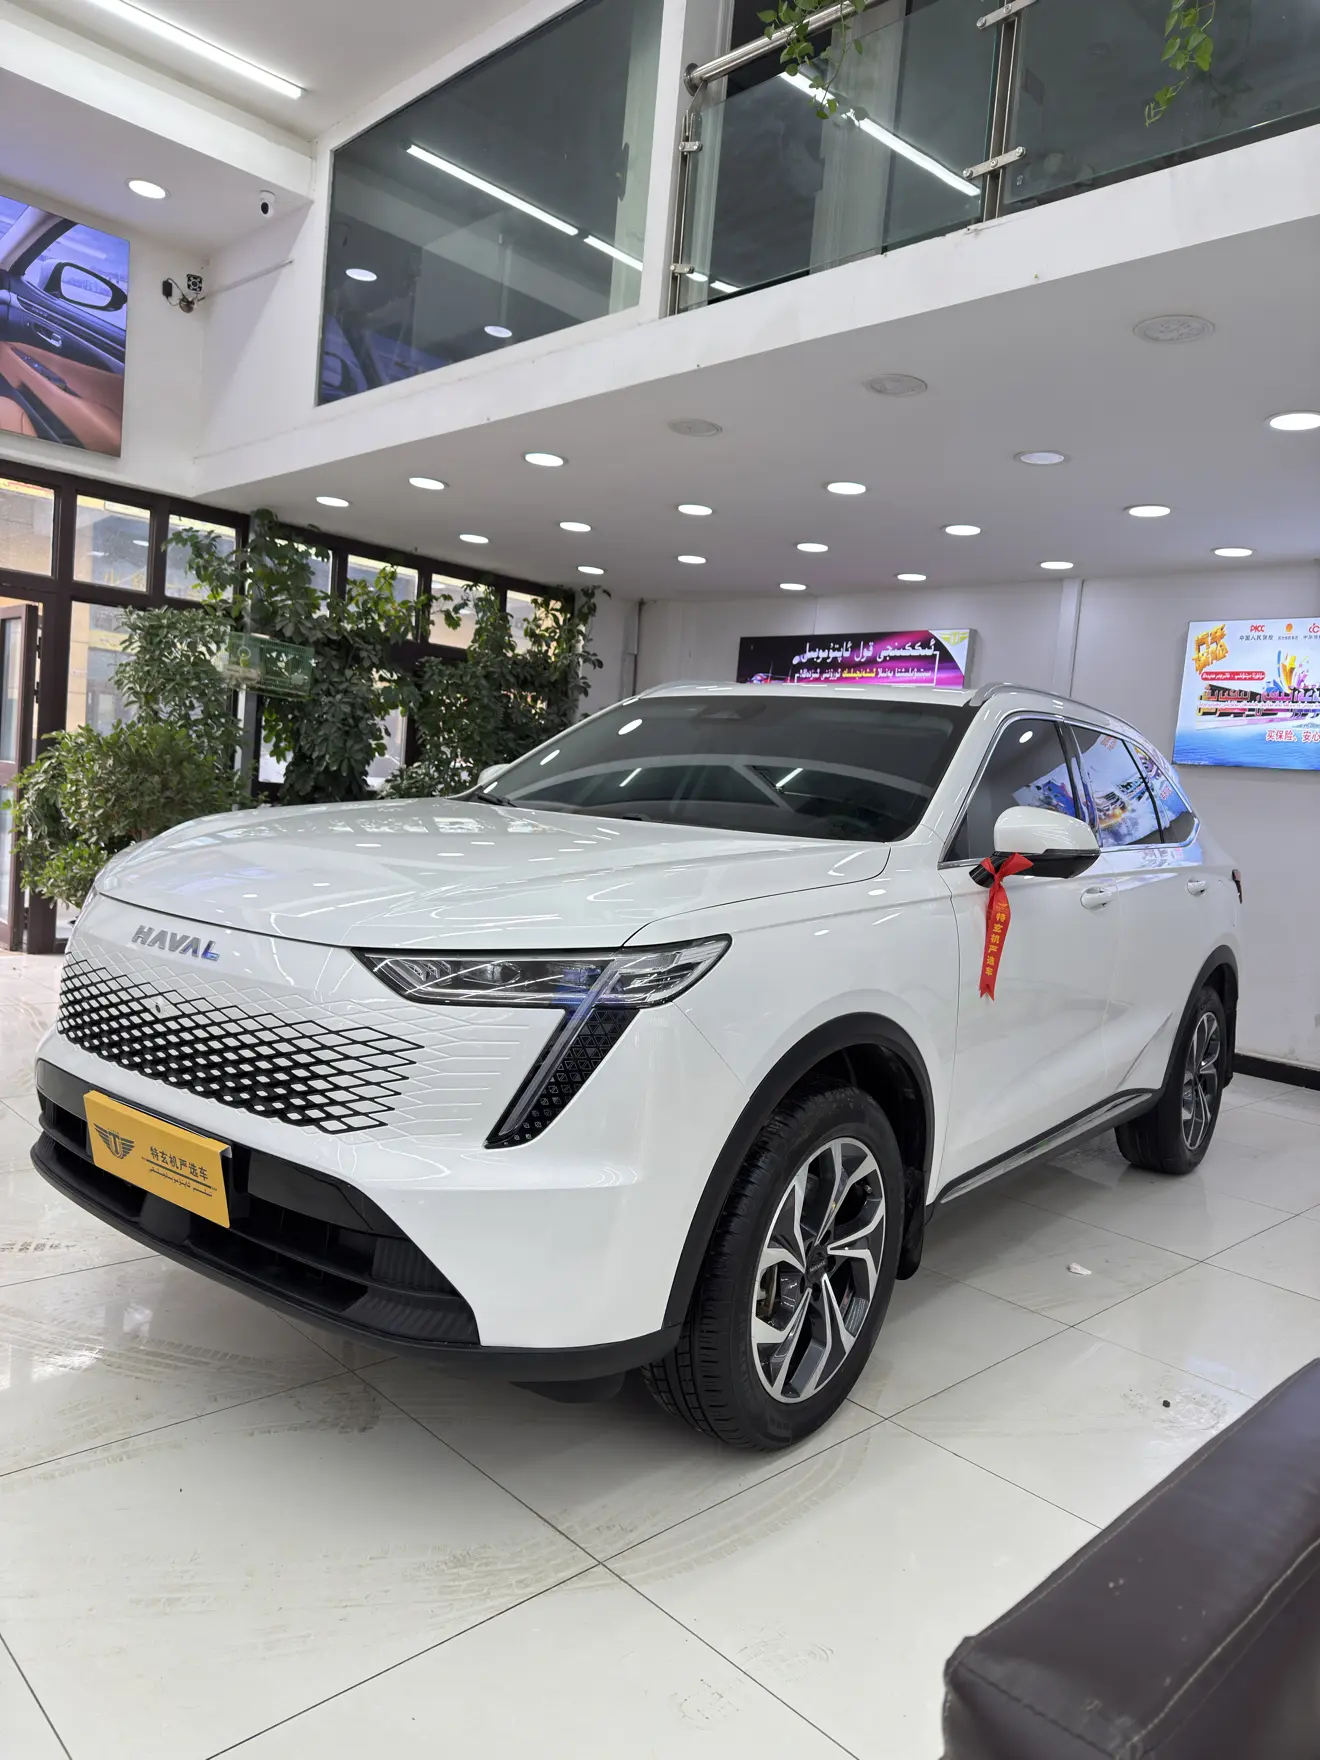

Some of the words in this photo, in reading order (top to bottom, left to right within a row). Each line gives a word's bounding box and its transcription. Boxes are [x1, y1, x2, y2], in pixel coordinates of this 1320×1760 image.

[1250, 624, 1265, 633] PICC
[854, 640, 874, 662] قول
[131, 924, 220, 961] HAVAL
[149, 1145, 209, 1181] 特玄机严选车
